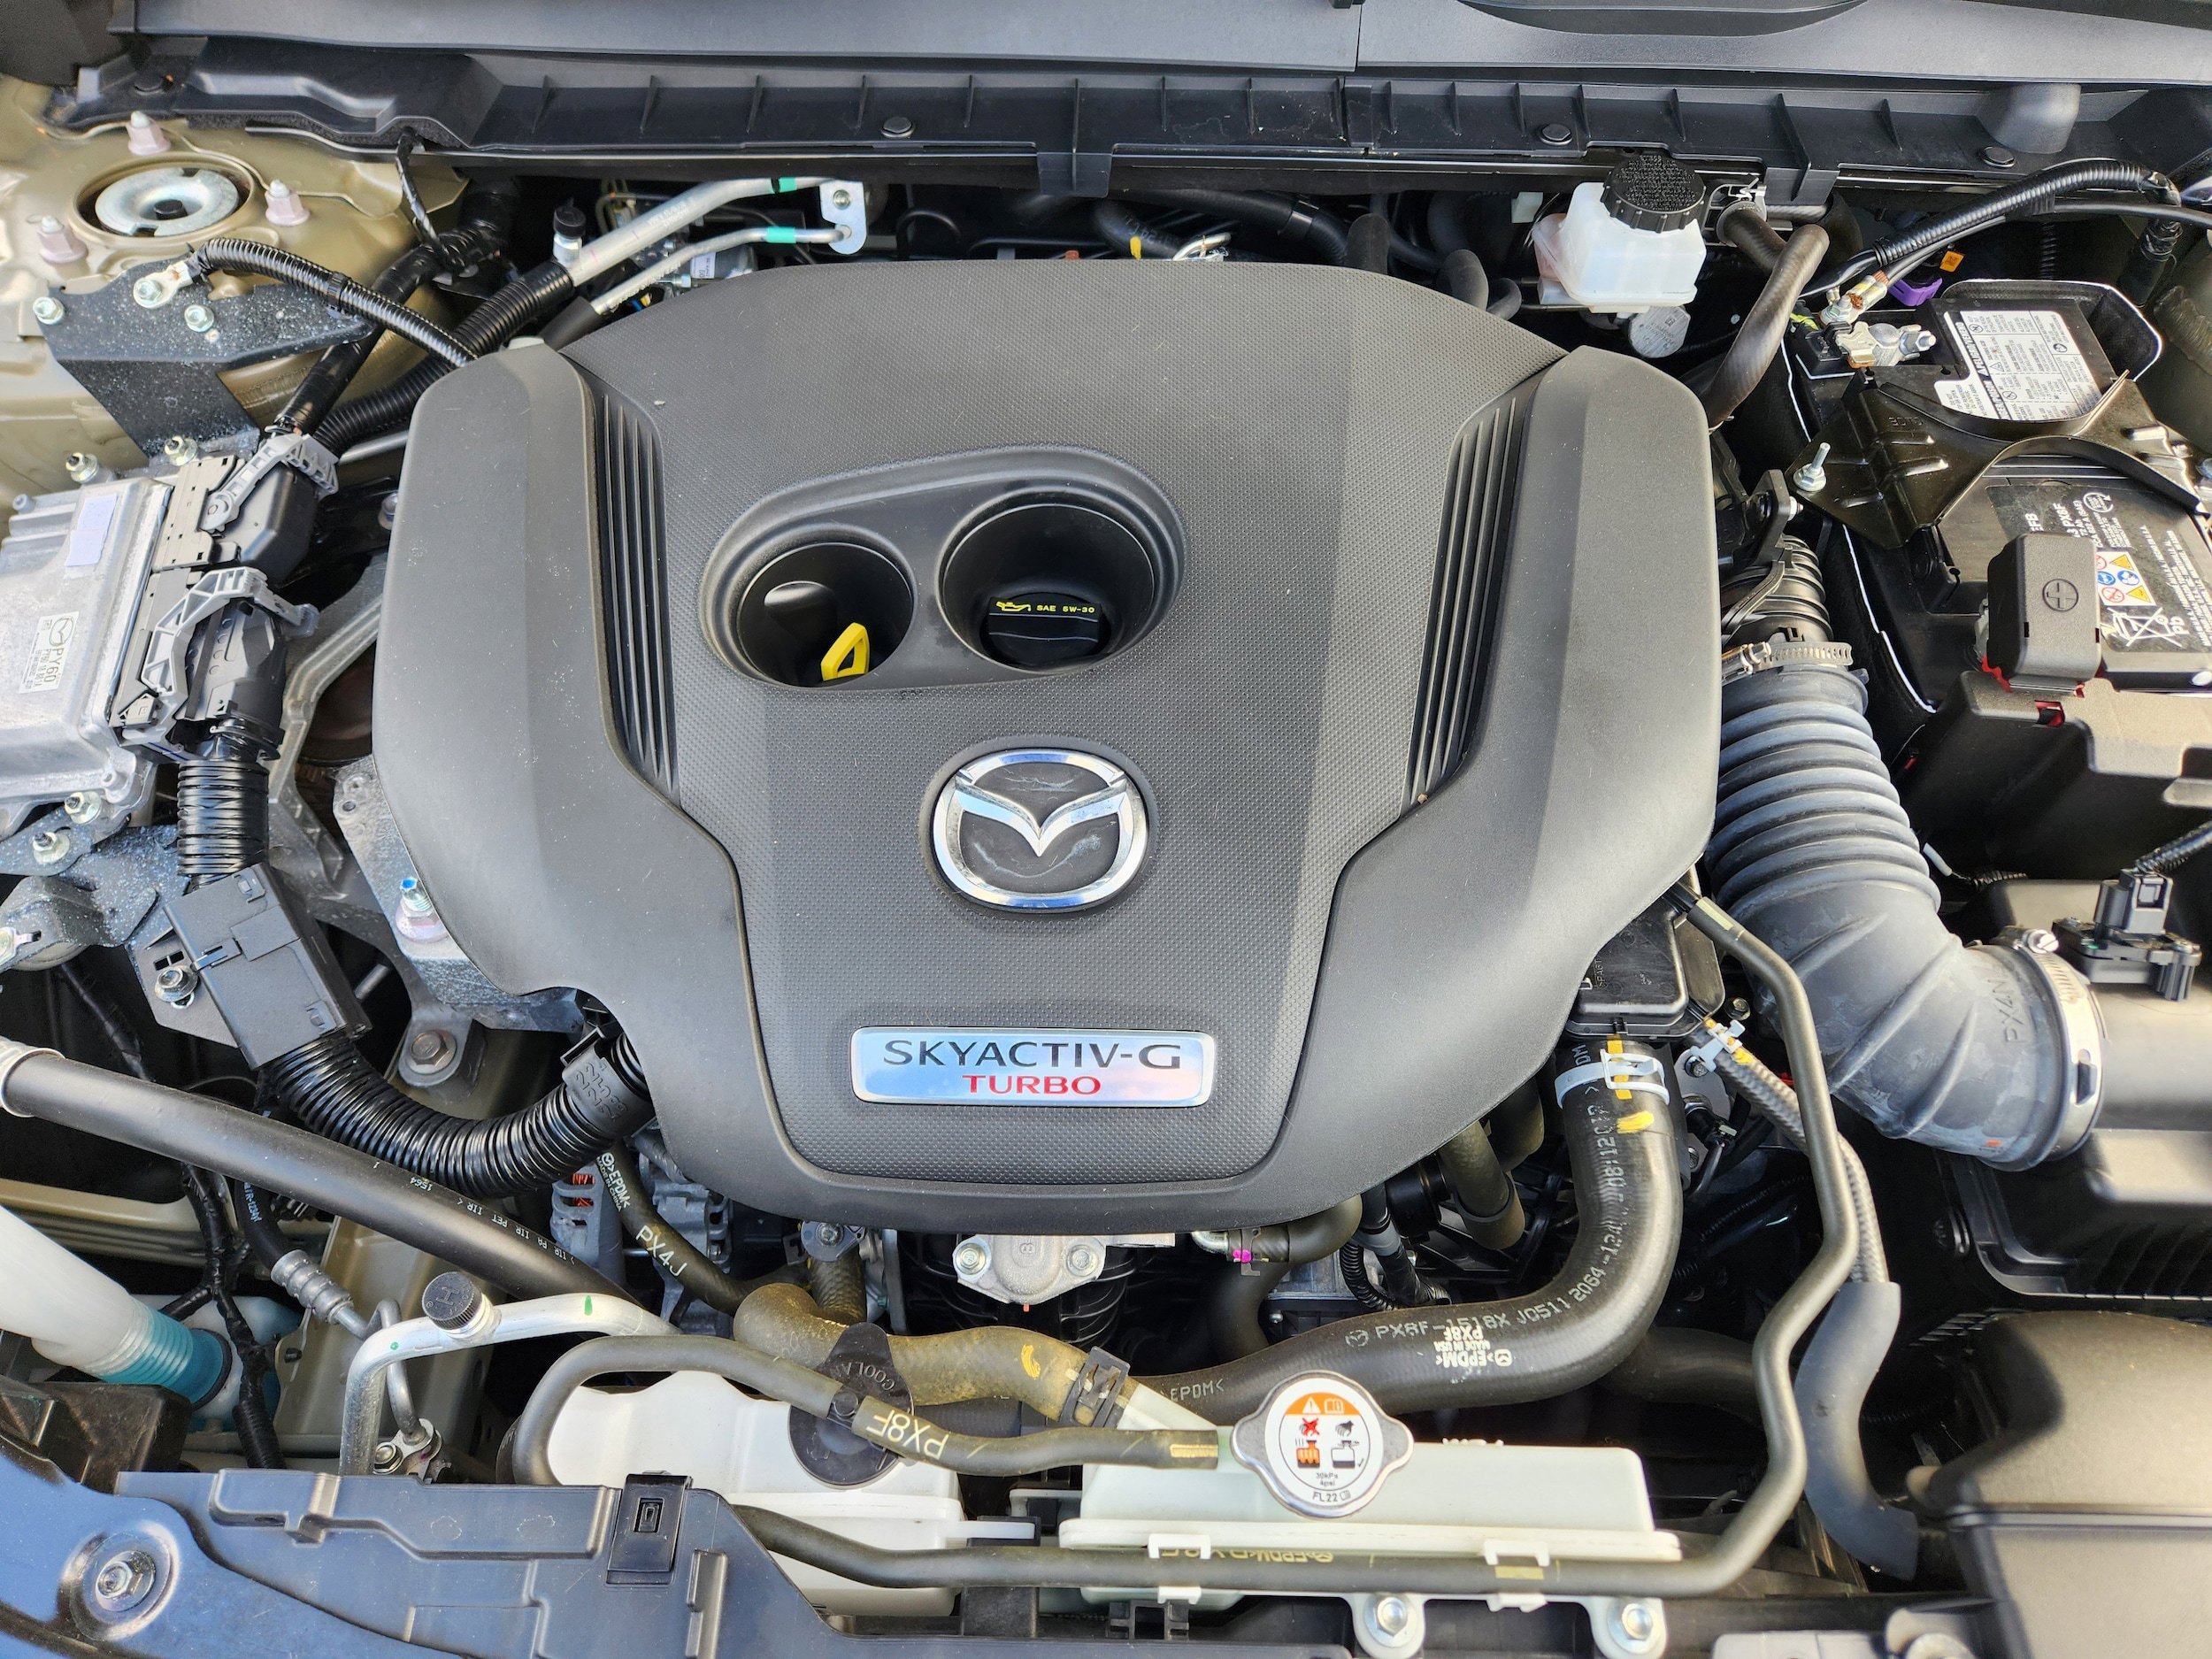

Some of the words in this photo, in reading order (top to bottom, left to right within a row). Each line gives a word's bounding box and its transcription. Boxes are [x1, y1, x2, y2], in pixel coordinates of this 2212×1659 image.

[2053, 503, 2076, 527] PX8F
[1063, 605, 1095, 614] 5W-30
[2170, 615, 2190, 635] Pb
[42, 647, 65, 682] PY60
[883, 1040, 1181, 1070] SKYACTIV-G
[962, 1074, 1102, 1095] TURBO
[408, 1173, 434, 1193] 1564
[595, 1156, 609, 1178] MADE
[604, 1178, 612, 1187] IN
[608, 1187, 622, 1212] CHINA
[489, 1212, 509, 1228] PET
[634, 1225, 687, 1278] PX4J
[865, 1409, 949, 1460] PX8F
[1312, 1492, 1339, 1502] FL22
